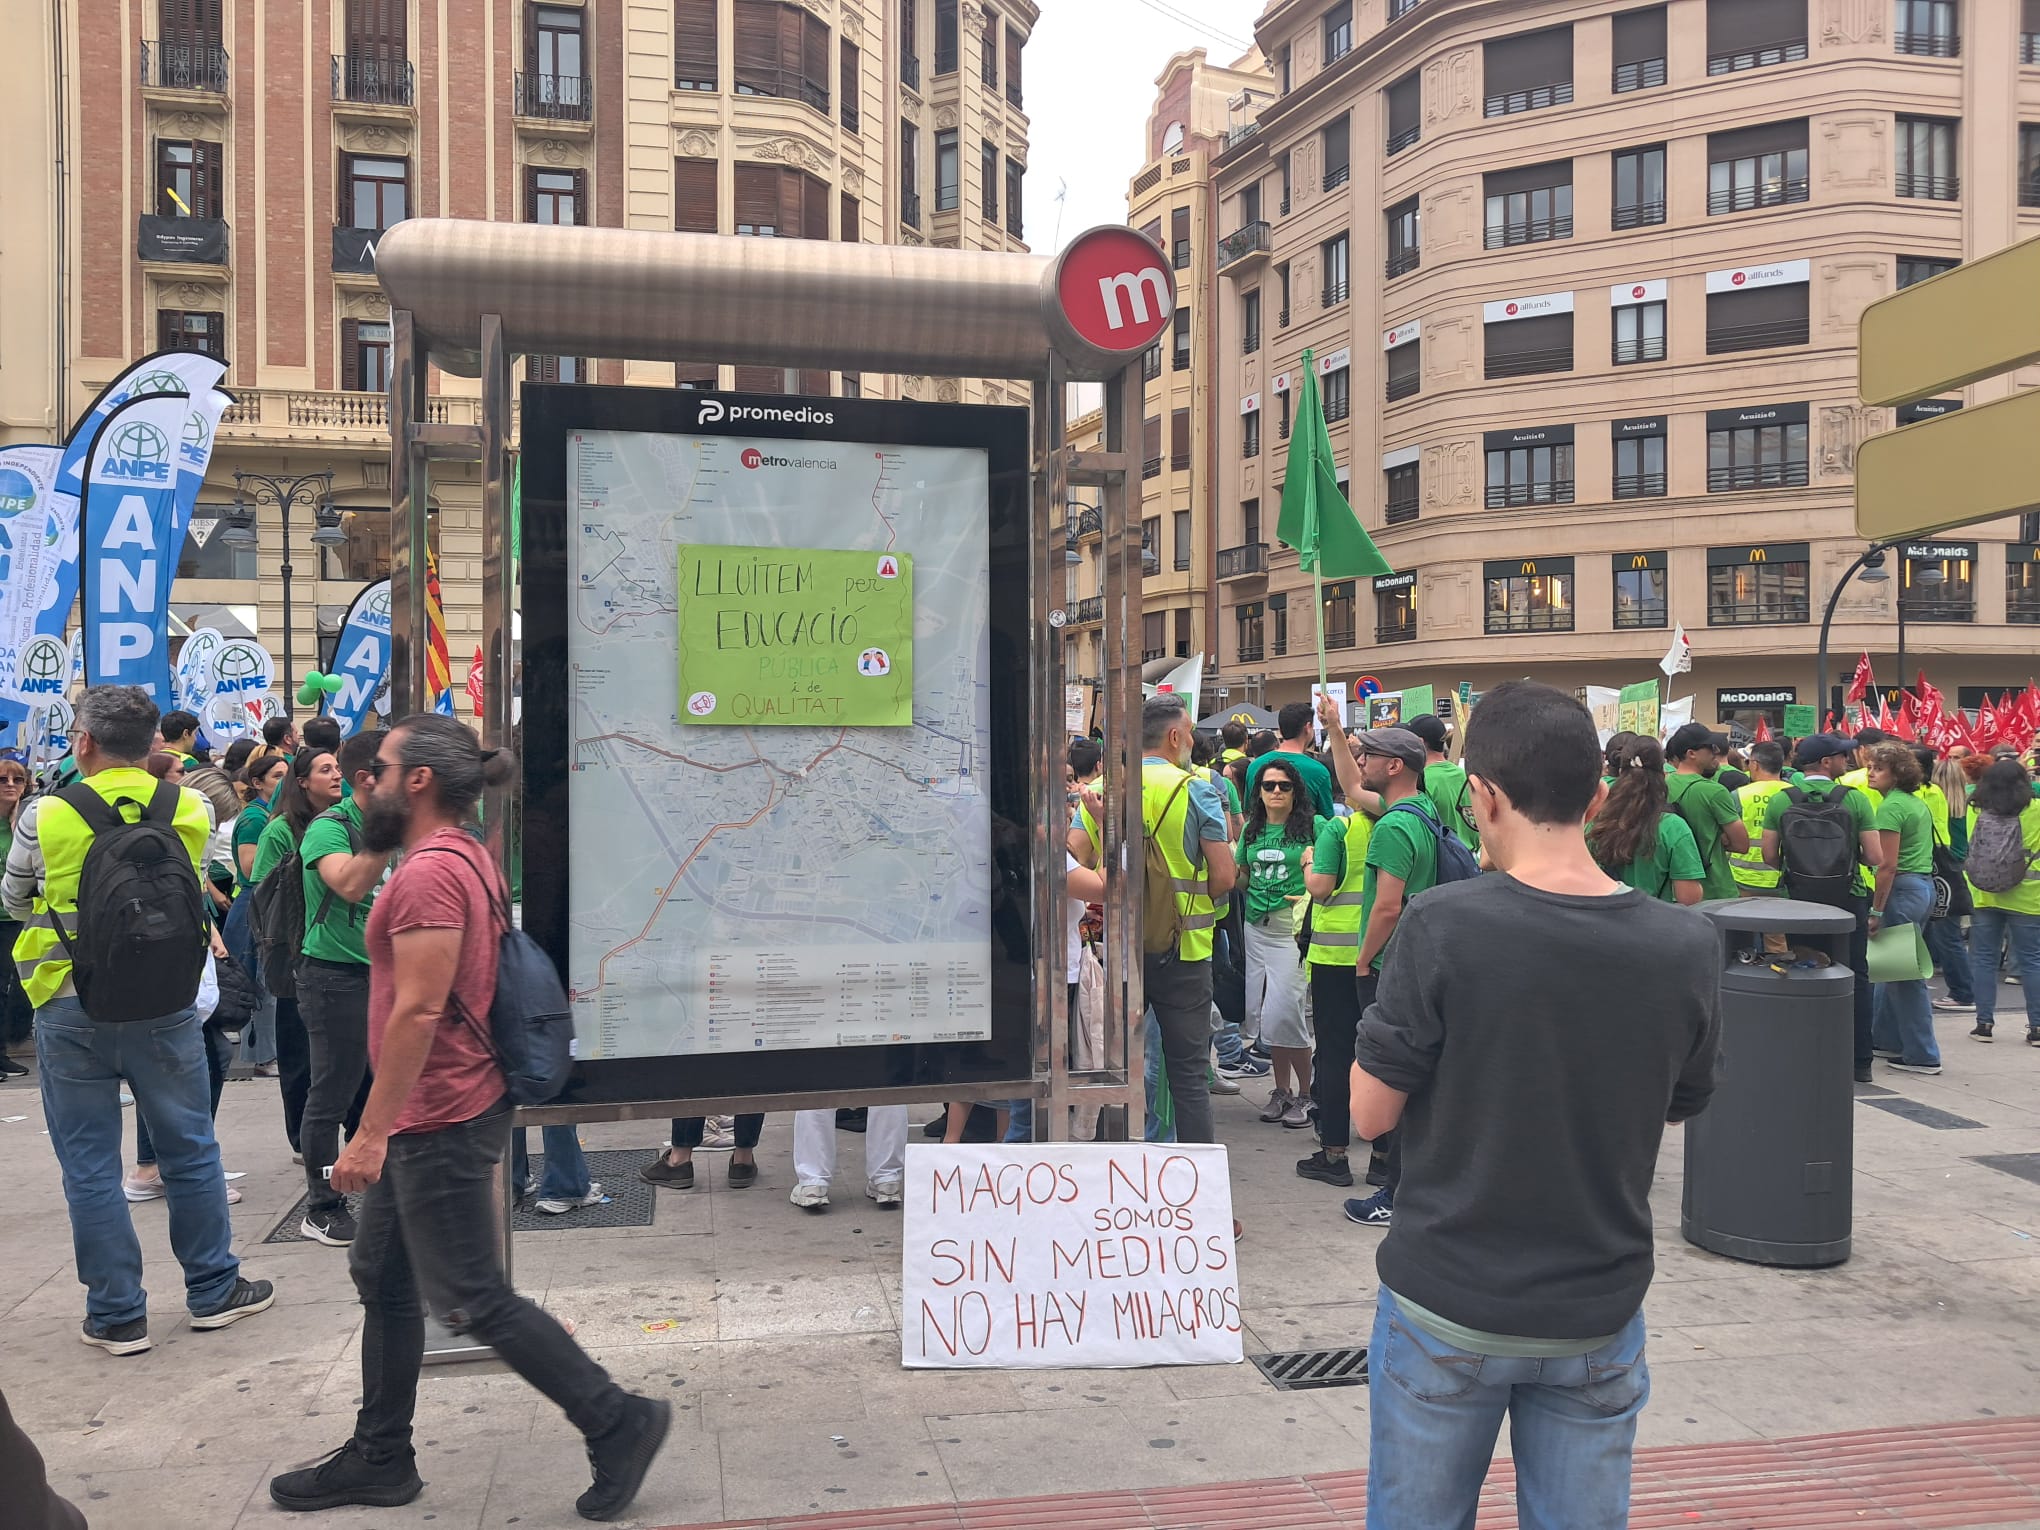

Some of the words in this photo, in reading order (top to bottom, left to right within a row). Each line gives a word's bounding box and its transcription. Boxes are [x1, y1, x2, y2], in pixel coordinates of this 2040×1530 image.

[1748, 268, 1783, 280] allfunds
[1098, 267, 1171, 330] m
[1520, 300, 1551, 311] allfunds
[729, 406, 834, 424] promedios
[1739, 412, 1767, 420] Acuitis
[1622, 423, 1648, 432] Acuitis
[1512, 433, 1537, 441] Acuitis
[101, 458, 170, 479] ANPE
[748, 455, 837, 470] metrovalencia
[22, 531, 42, 609] Profesionalidad
[845, 576, 885, 606] per
[1375, 575, 1414, 589] McDonald's
[100, 494, 157, 696] ANP
[357, 609, 391, 626] ANP
[759, 651, 840, 681] PÚBLICA
[20, 678, 63, 694] ANPE
[215, 675, 268, 694] ANPE
[807, 681, 824, 694] de
[731, 693, 845, 719] QUALITAT
[1720, 692, 1793, 703] McDonald's
[933, 1161, 1079, 1216] MAGOS
[1108, 1153, 1199, 1208] NO
[1094, 1207, 1193, 1232] SOMOS
[930, 1236, 1017, 1286] SIN
[1052, 1235, 1228, 1280] MEDIOS
[922, 1291, 992, 1357] NO
[1015, 1290, 1087, 1350] HAY
[1111, 1286, 1242, 1340] MILAGROS
